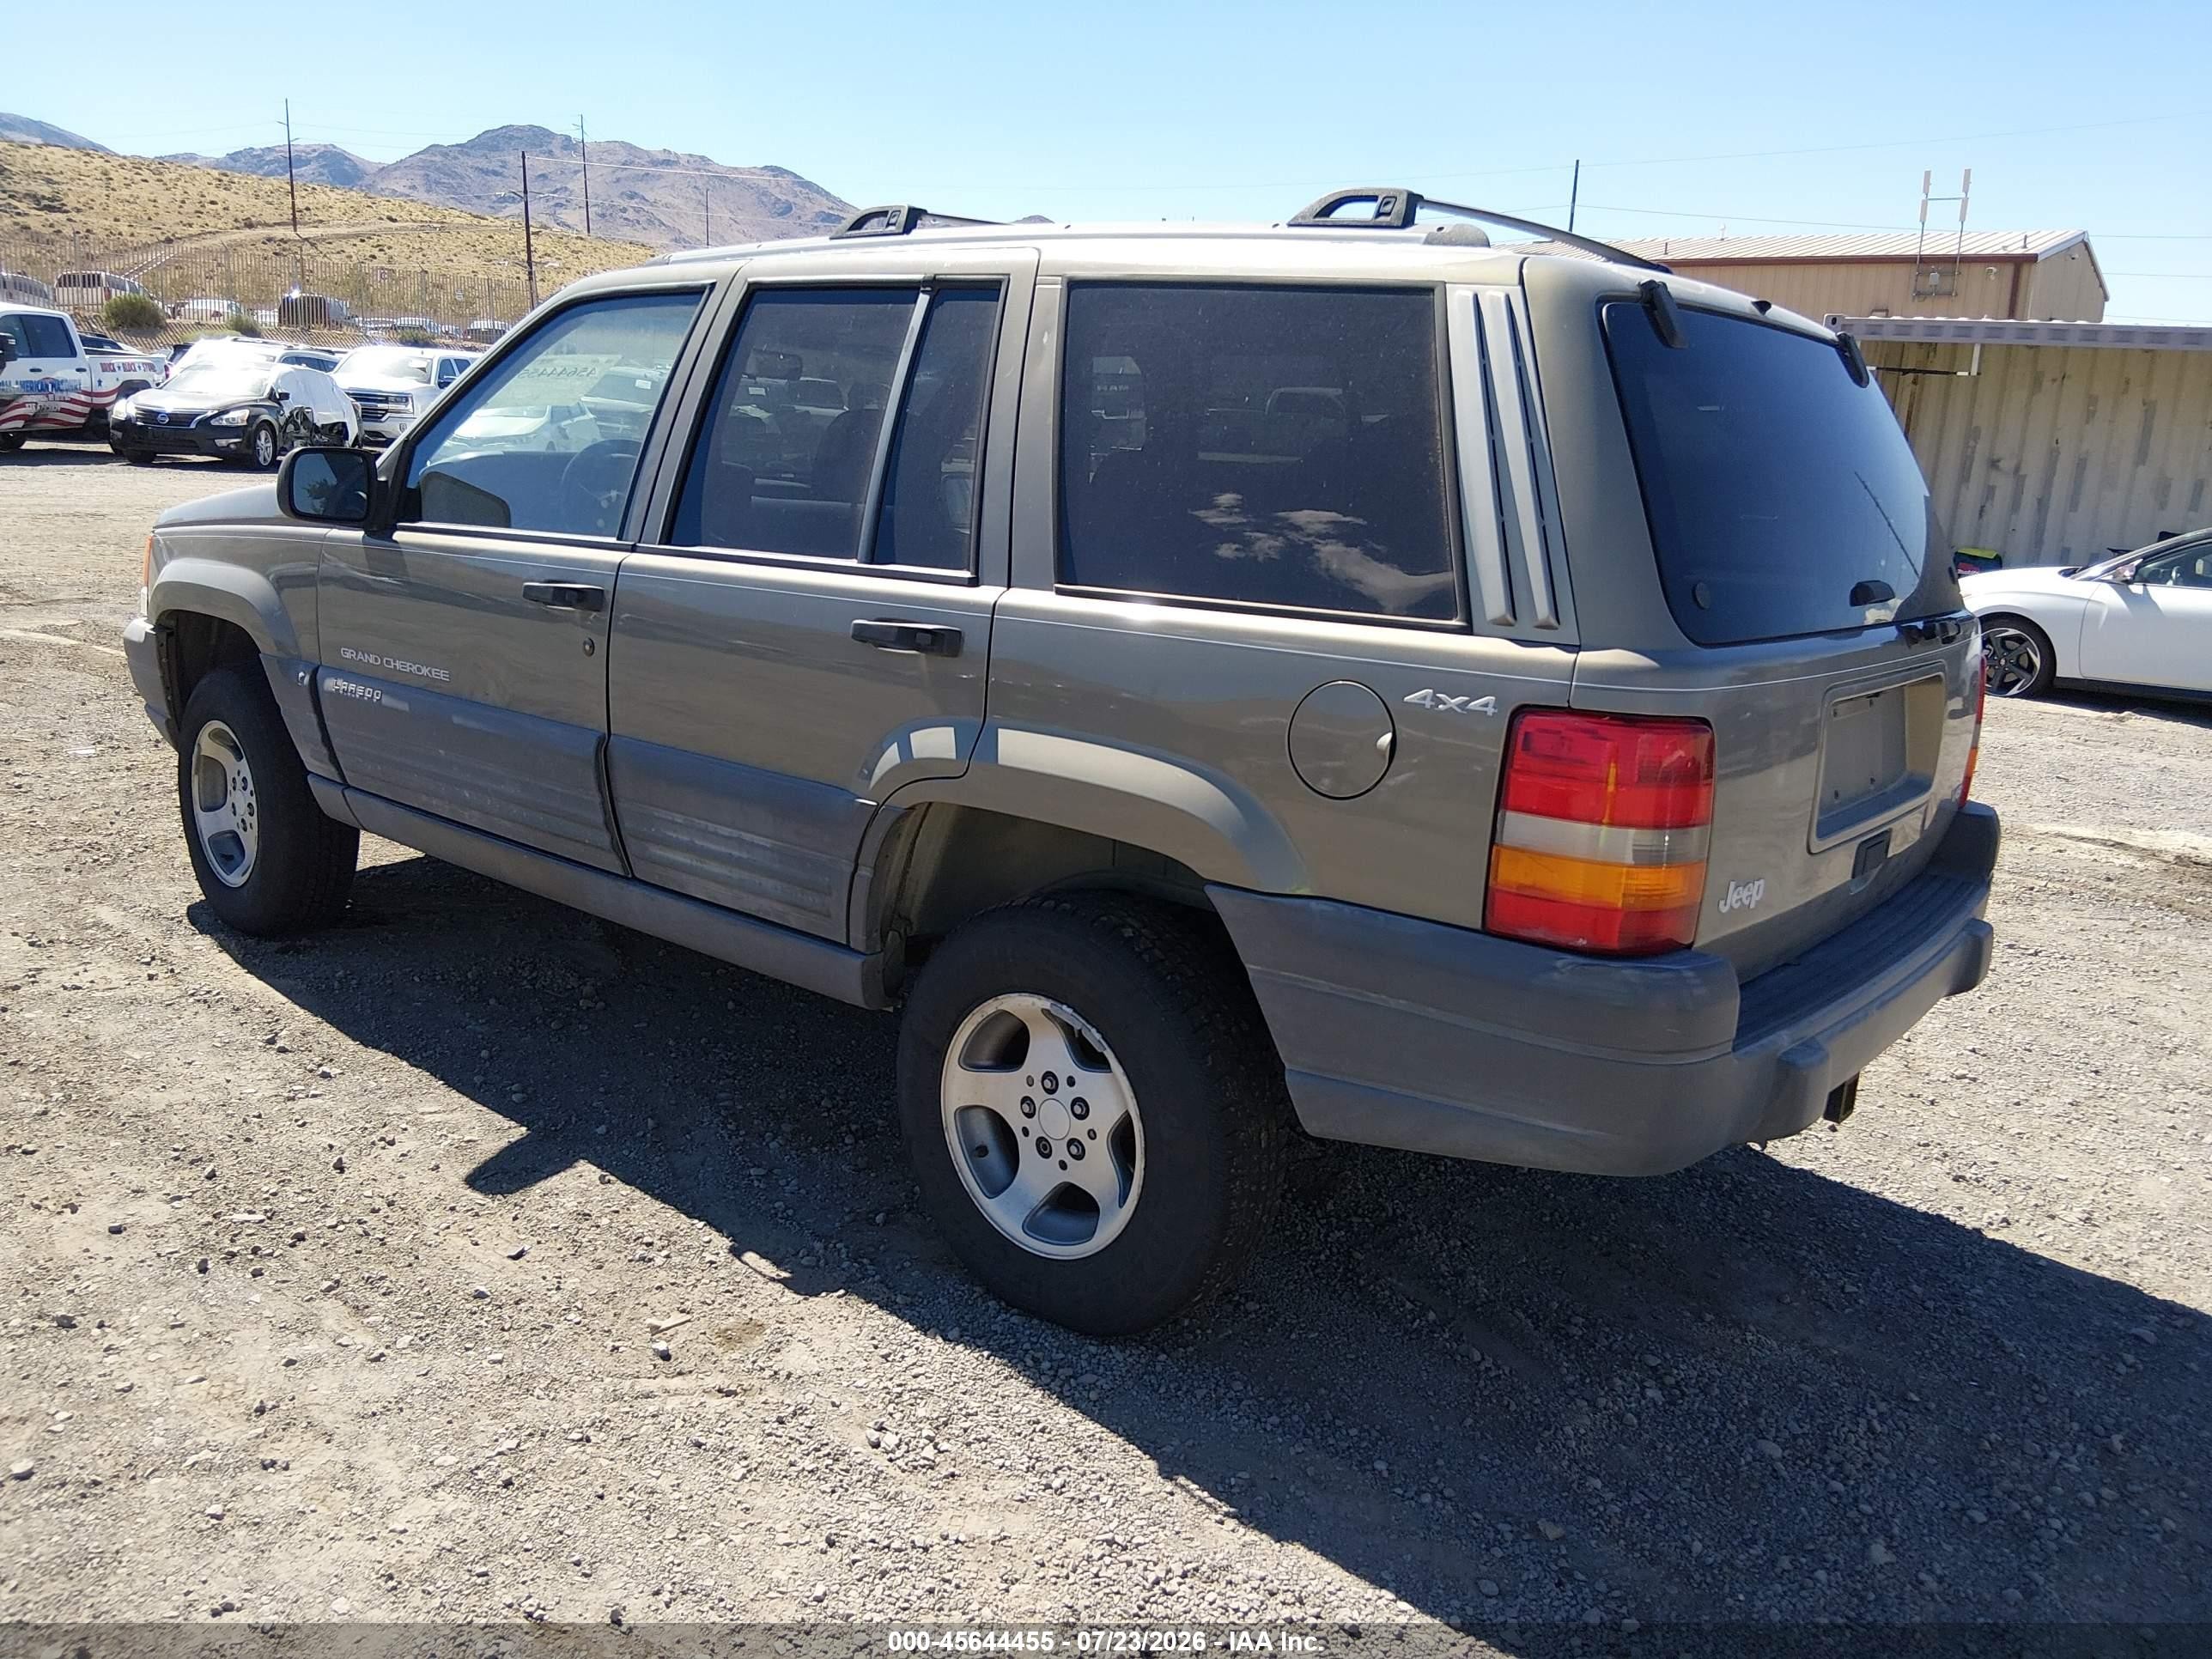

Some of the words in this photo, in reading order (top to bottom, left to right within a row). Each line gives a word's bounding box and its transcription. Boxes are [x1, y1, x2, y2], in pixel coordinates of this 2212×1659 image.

[341, 647, 381, 665] GRAND
[383, 657, 450, 681] CHEROKEE
[1719, 878, 1765, 913] Jeep
